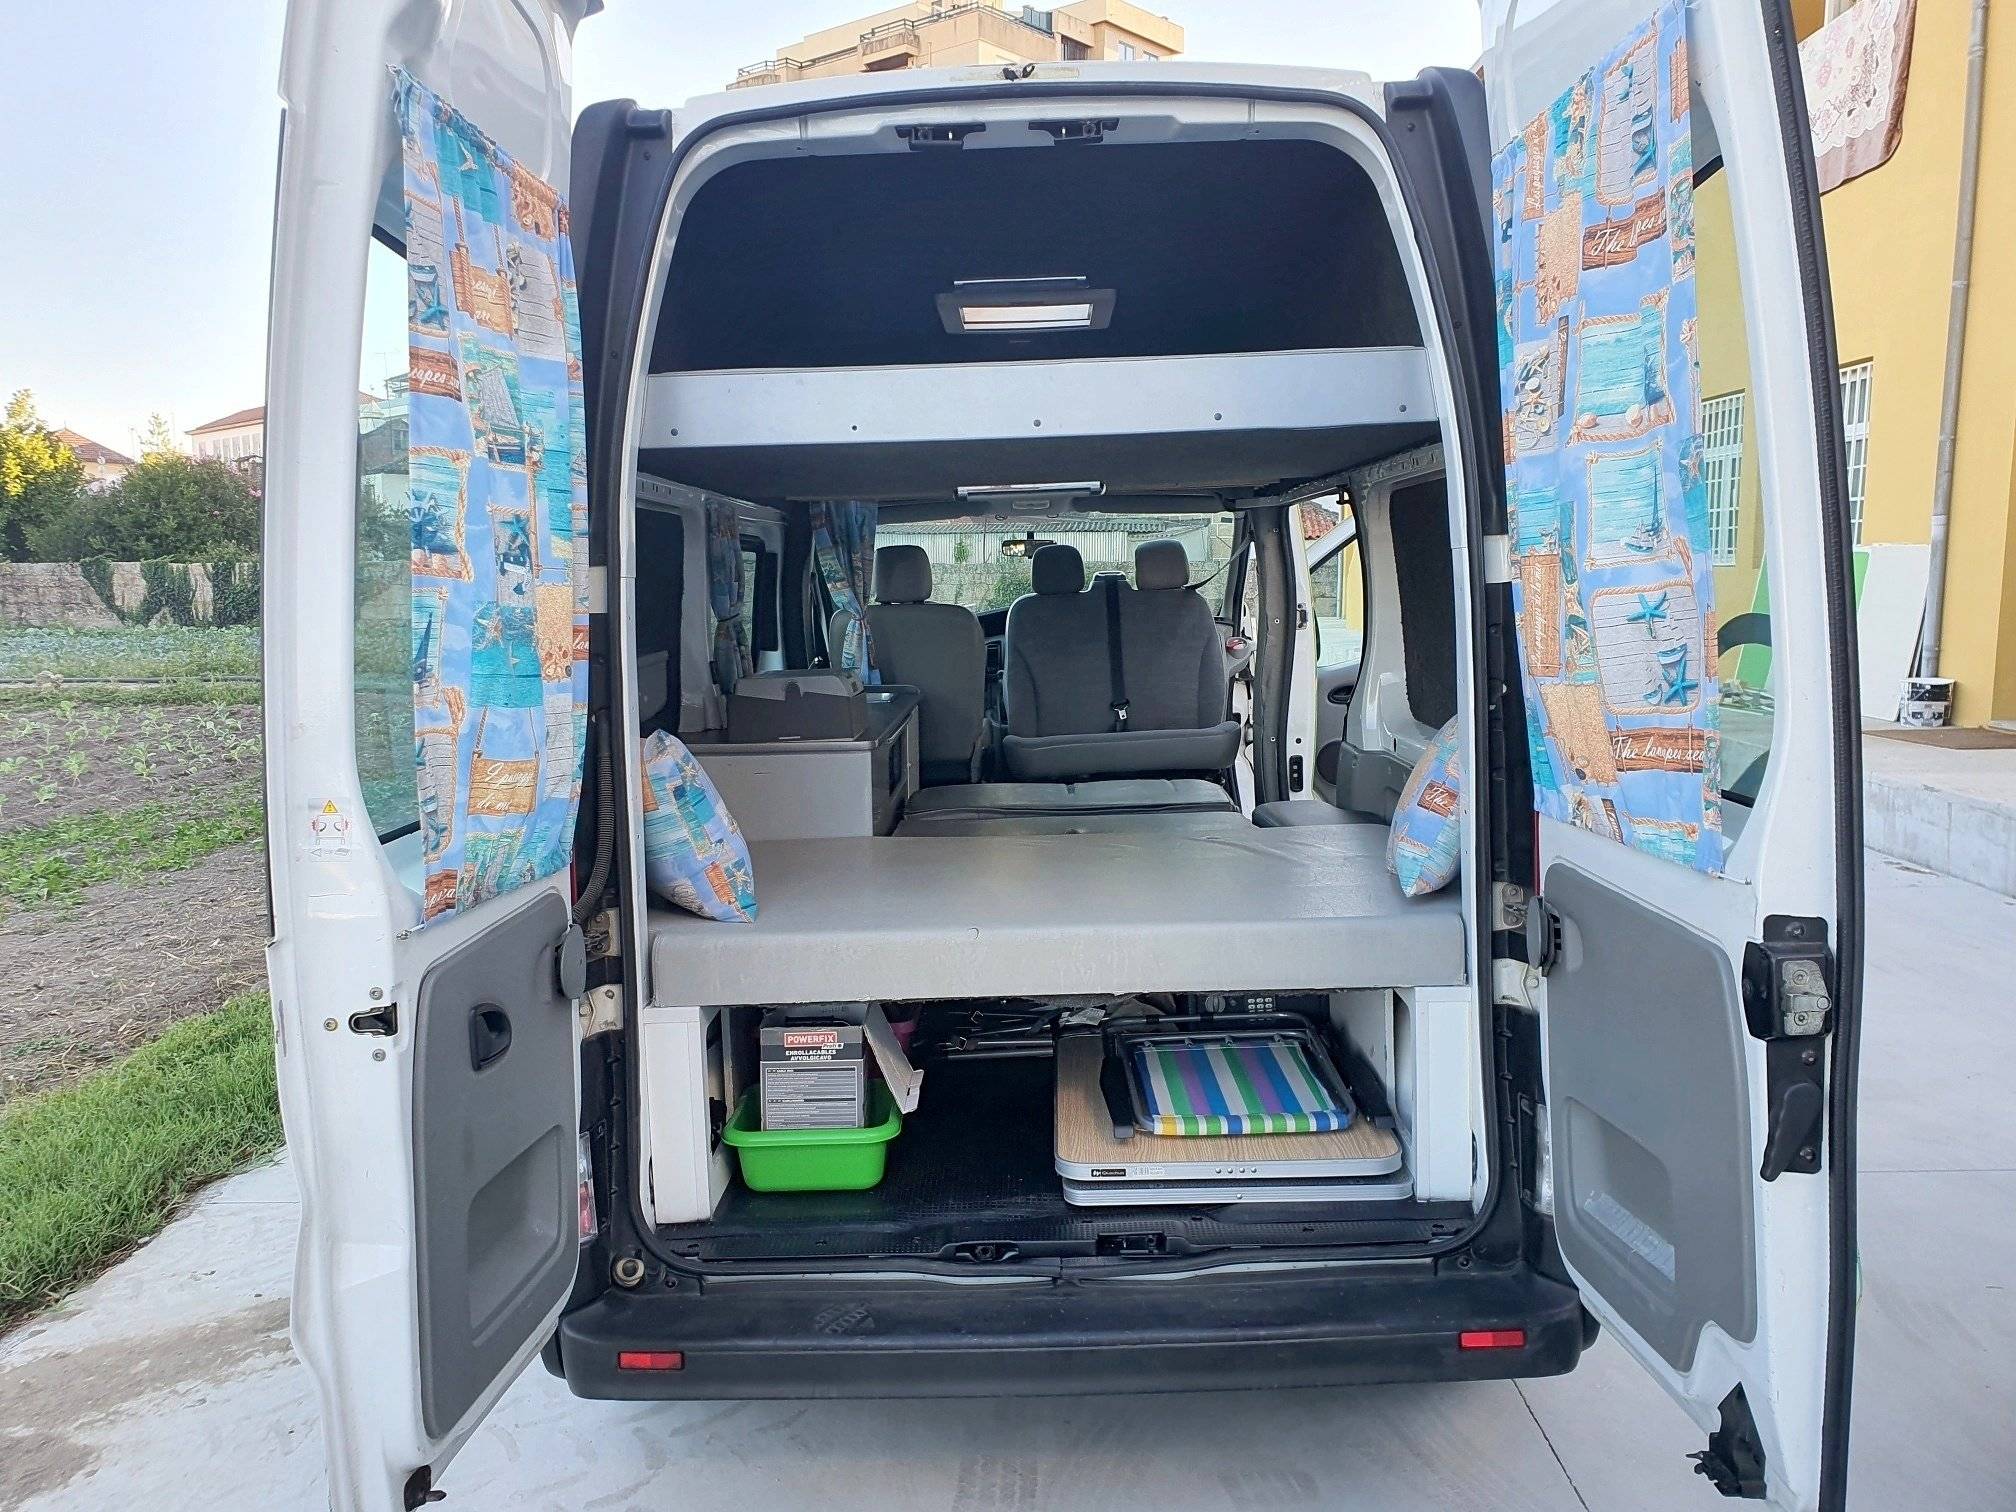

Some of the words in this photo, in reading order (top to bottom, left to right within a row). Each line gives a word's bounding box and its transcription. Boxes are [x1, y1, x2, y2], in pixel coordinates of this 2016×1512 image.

[1592, 227, 1624, 256] The
[1612, 736, 1639, 760] The
[787, 1034, 835, 1044] POWERFIX
